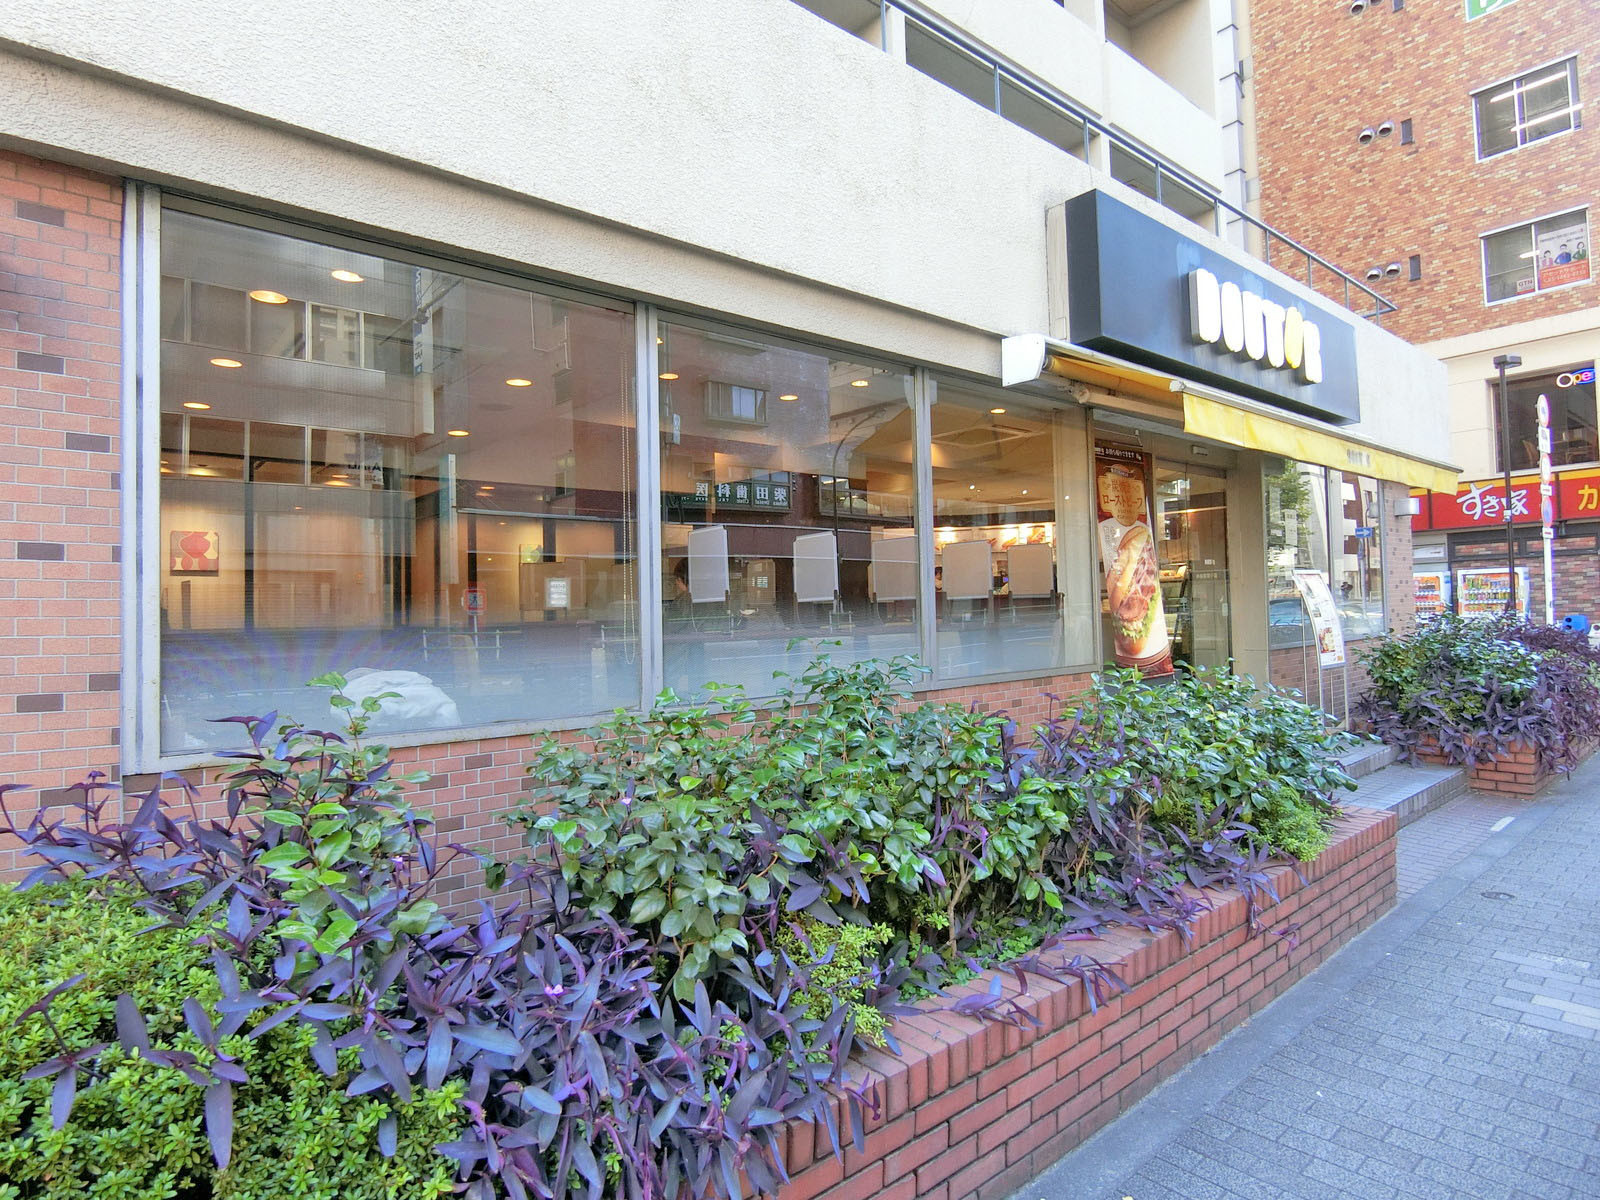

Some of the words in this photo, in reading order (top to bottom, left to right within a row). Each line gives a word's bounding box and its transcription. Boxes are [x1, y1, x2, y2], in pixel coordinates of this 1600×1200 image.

[1189, 268, 1322, 384] DOUTOR
[1456, 483, 1529, 520] すき家
